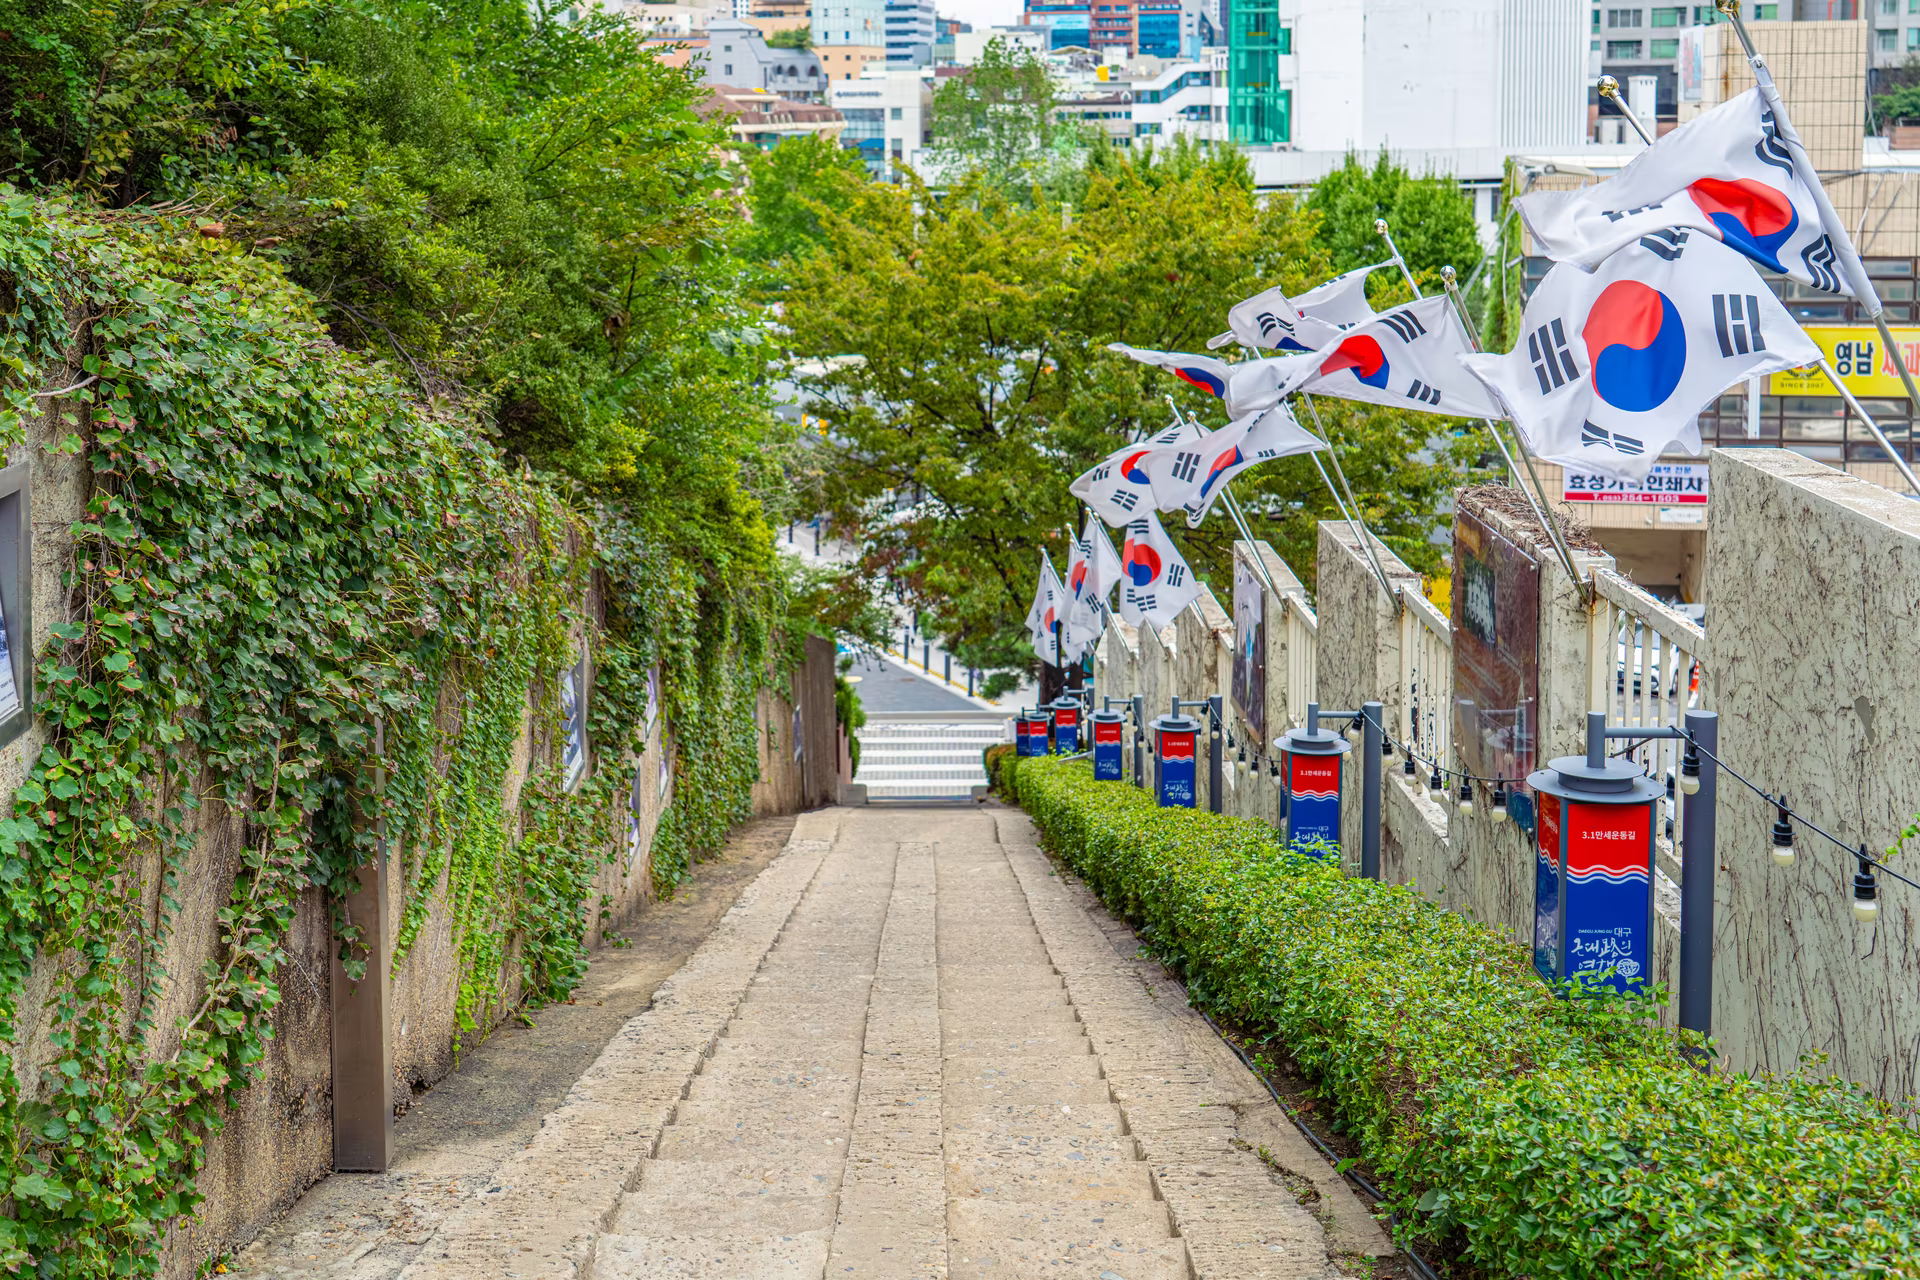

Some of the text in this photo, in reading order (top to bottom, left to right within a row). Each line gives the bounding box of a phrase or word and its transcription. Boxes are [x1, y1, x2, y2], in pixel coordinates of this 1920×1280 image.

[1836, 342, 1874, 376] 영남
[1582, 830, 1636, 841] 3.1만세운동길
[1614, 927, 1632, 937] 대구
